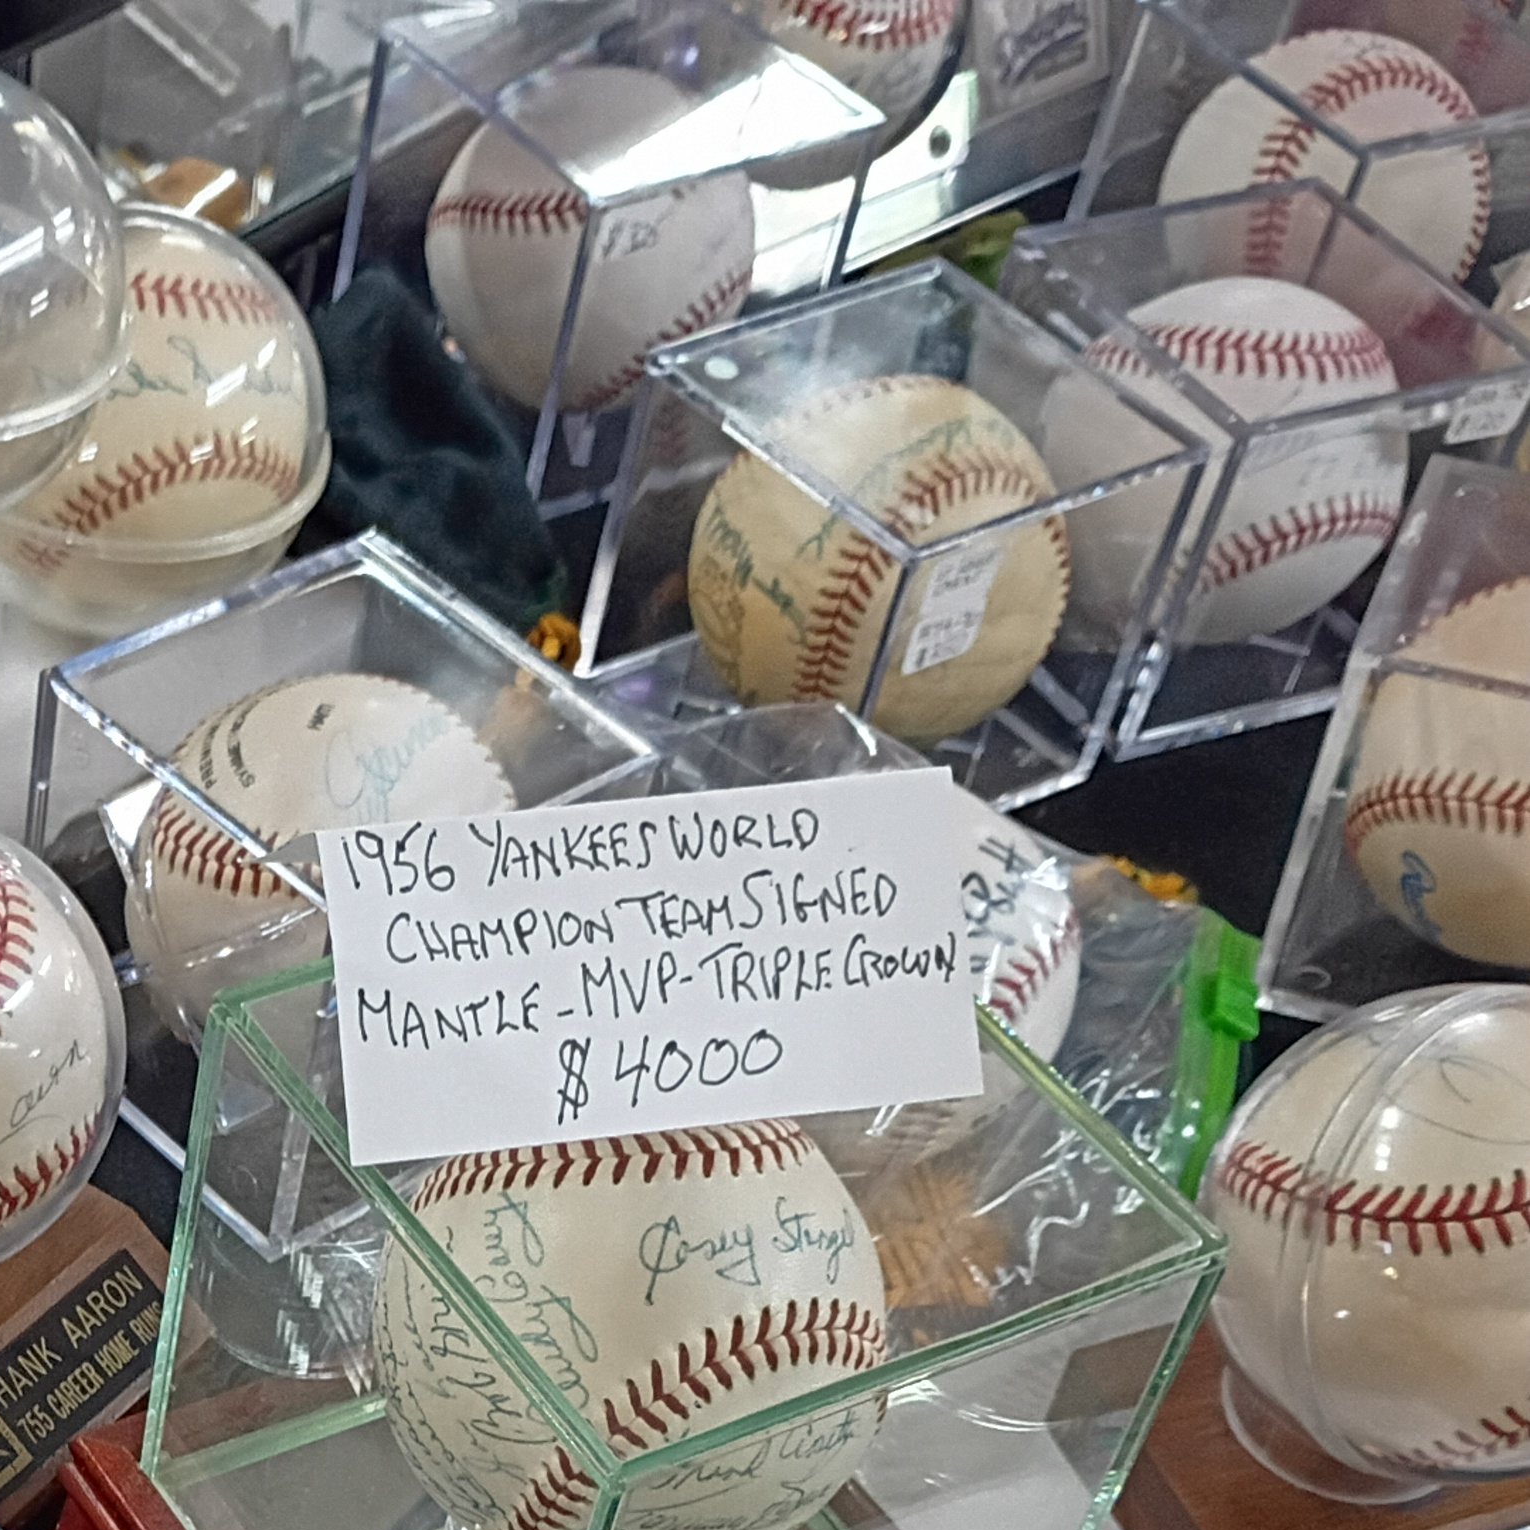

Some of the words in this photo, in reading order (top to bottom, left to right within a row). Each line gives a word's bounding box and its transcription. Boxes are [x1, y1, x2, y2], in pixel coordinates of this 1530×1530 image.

[341, 821, 456, 895] 1956
[468, 816, 659, 887] YANKEES
[667, 807, 820, 860] WORLD
[385, 904, 615, 965] CHAMPION
[616, 890, 733, 941] TEAM
[732, 868, 899, 932] SIGNED
[842, 930, 958, 986] CROWN
[60, 1264, 145, 1349] AARON
[15, 1402, 55, 1446] 755
[45, 1354, 106, 1420] CAREER
[94, 1330, 140, 1379] HOME
